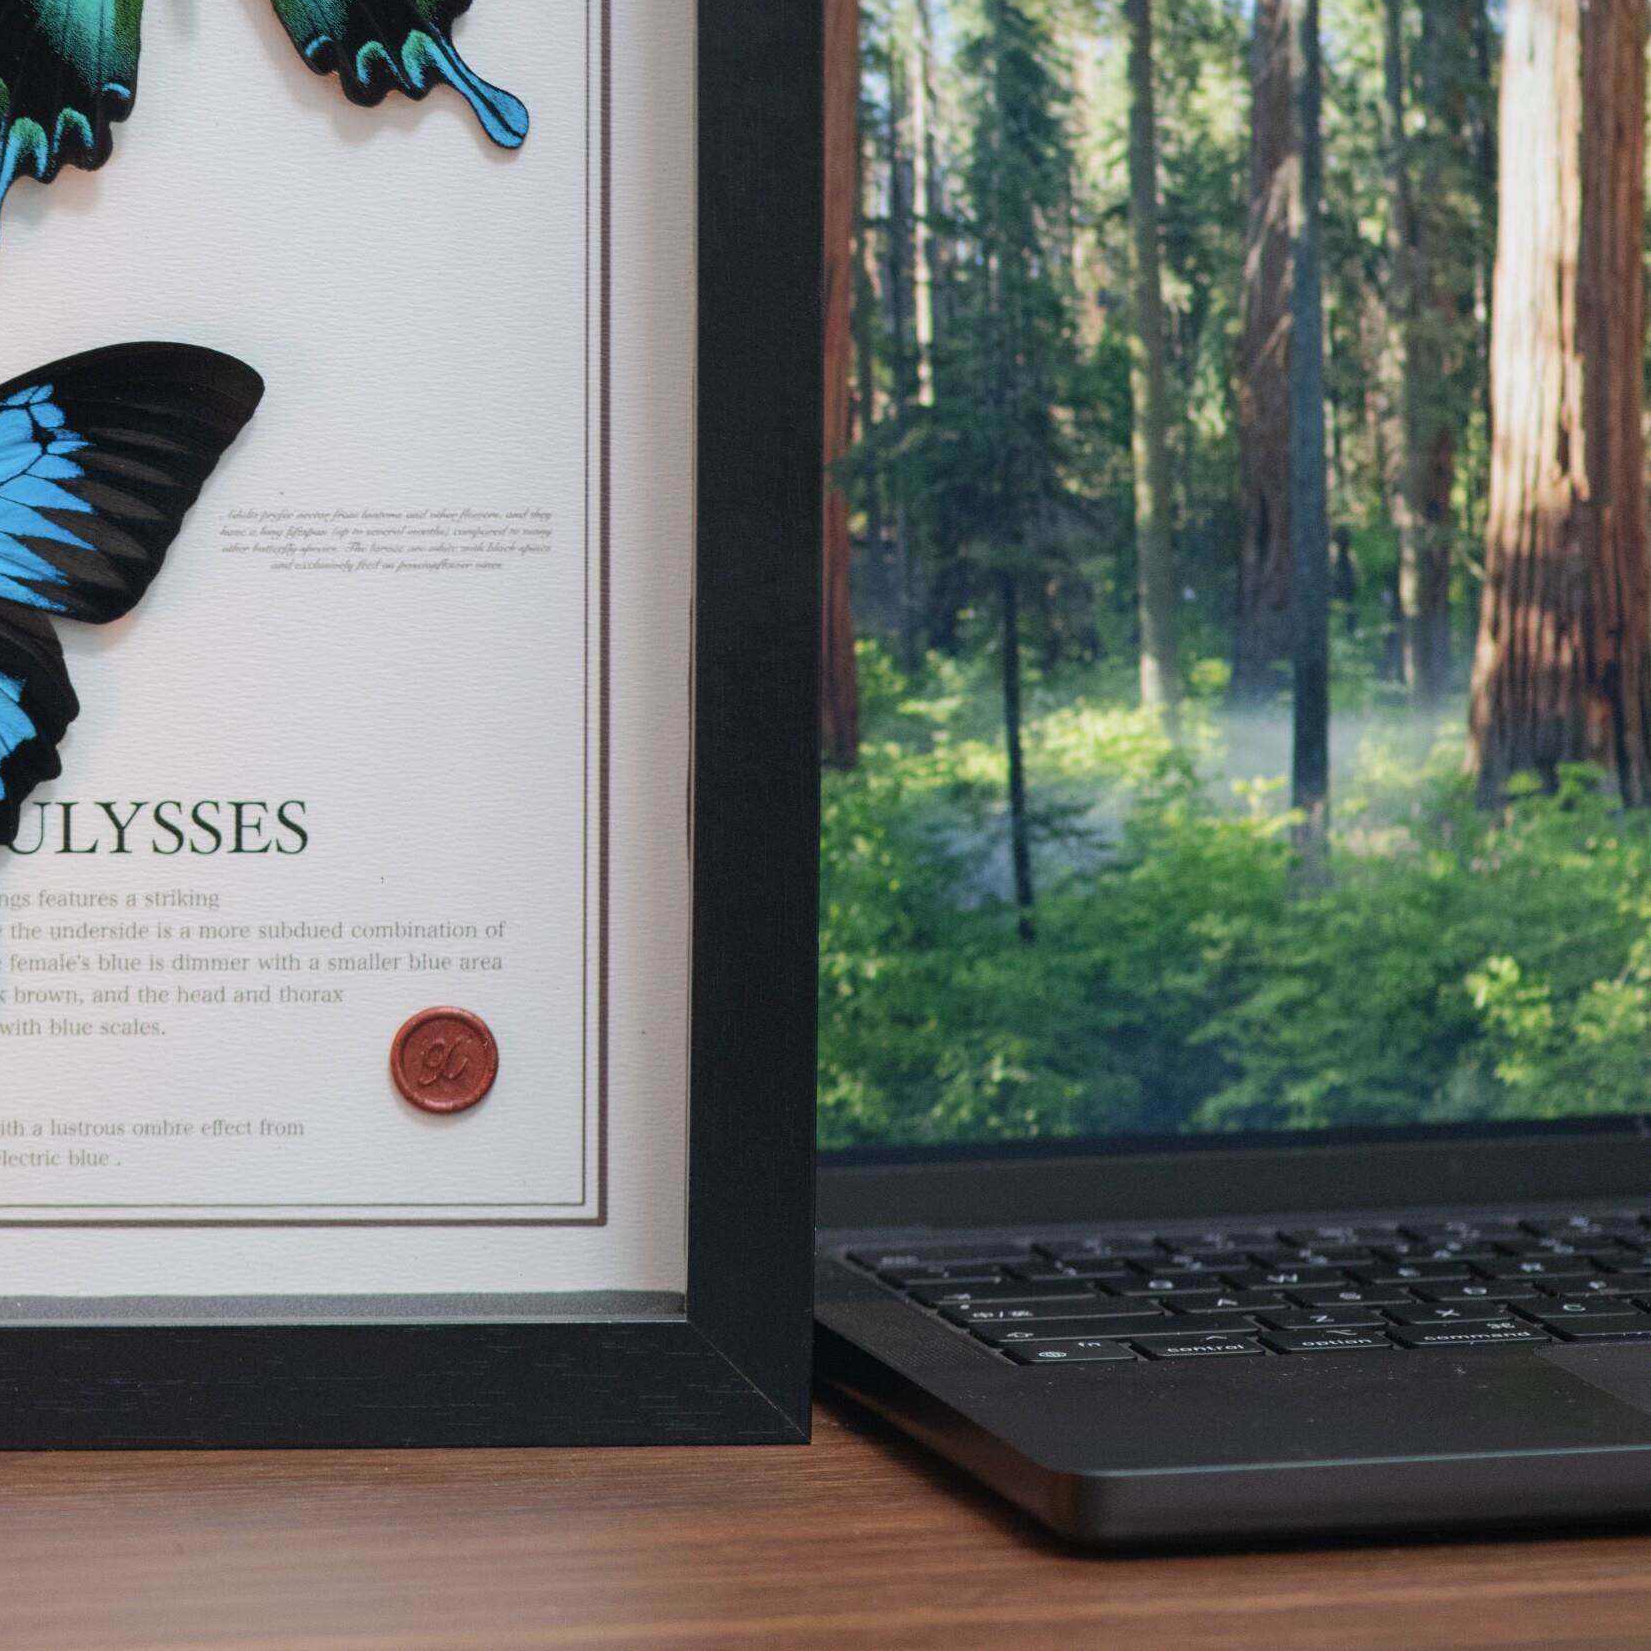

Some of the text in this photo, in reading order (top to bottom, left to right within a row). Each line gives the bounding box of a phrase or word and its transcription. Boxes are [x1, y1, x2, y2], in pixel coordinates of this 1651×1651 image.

[38, 889, 118, 906] features
[126, 894, 137, 906] a
[145, 889, 220, 912] striking
[11, 921, 42, 938] the
[50, 921, 149, 938] underside
[157, 921, 172, 938] is
[180, 926, 191, 938] a
[199, 926, 250, 938] more
[259, 921, 343, 938] subdued
[351, 921, 477, 938] combination
[485, 921, 506, 938] of
[10, 953, 90, 970] female's
[98, 953, 141, 970] blue
[149, 953, 164, 970] is
[172, 953, 250, 970] dimmer
[258, 953, 301, 970] with
[309, 958, 320, 970] a
[328, 953, 401, 970] smaller
[409, 953, 452, 970] blue
[460, 958, 503, 970] area
[14, 986, 84, 1005] brown,
[92, 986, 129, 1003] and
[138, 986, 169, 1003] the
[177, 986, 226, 1003] head
[233, 986, 271, 1003] and
[279, 986, 343, 1003] thorax
[0, 1018, 41, 1036] with
[50, 1018, 93, 1036] blue
[100, 1018, 166, 1036] scales.
[32, 1124, 43, 1136] a
[51, 1119, 125, 1136] lustrous
[132, 1119, 194, 1136] ombre
[201, 1119, 251, 1136] effect
[259, 1119, 305, 1136] from
[1302, 1337, 1372, 1347] option
[1423, 1330, 1532, 1341] command
[1167, 1343, 1244, 1353] control
